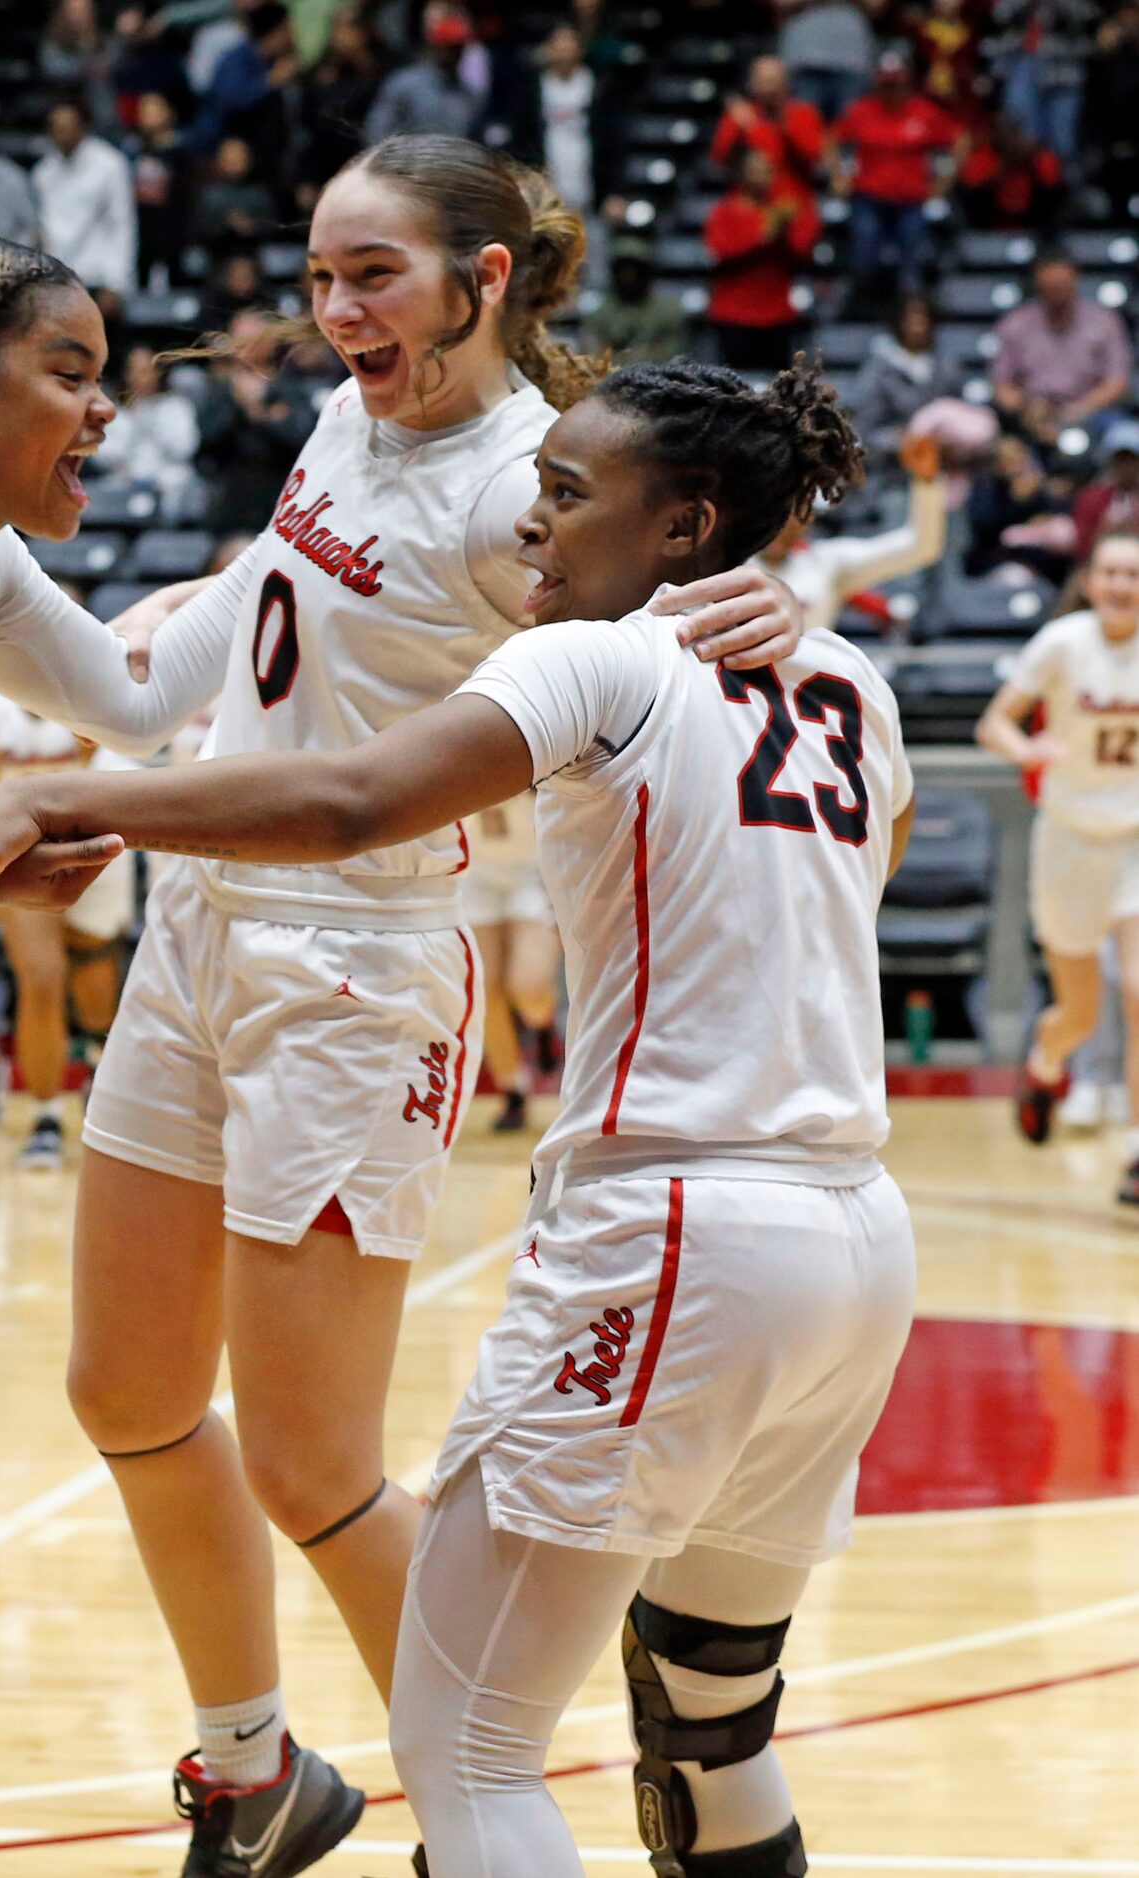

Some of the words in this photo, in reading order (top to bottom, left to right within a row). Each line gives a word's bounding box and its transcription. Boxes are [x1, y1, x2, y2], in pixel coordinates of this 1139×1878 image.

[273, 468, 384, 597] Redhawks
[252, 568, 300, 710] 0
[714, 660, 870, 849] 23
[1097, 727, 1137, 766] 12
